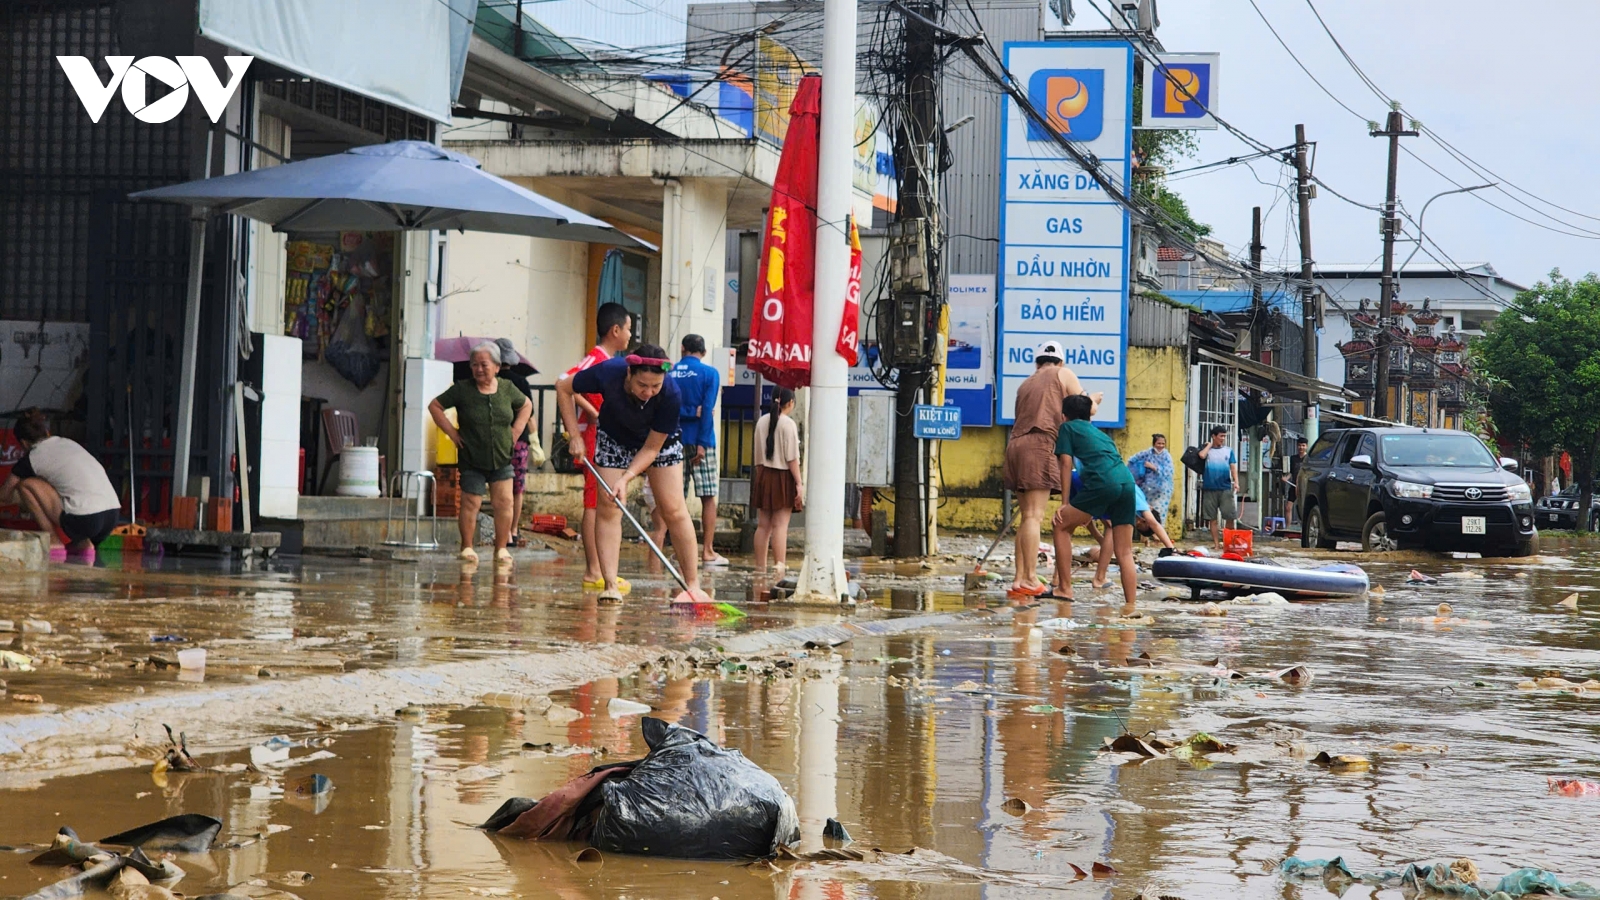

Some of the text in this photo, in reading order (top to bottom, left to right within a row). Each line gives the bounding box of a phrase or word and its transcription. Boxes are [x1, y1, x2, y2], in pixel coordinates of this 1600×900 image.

[1018, 169, 1069, 190] XĂNG
[1046, 218, 1083, 234] GAS
[1017, 254, 1110, 277] DẦU NHỜN
[1021, 297, 1104, 321] BẢO HIỂM
[1065, 345, 1115, 365] HÀNG
[919, 408, 958, 422] KIỆT 116
[938, 427, 956, 435] LONG
